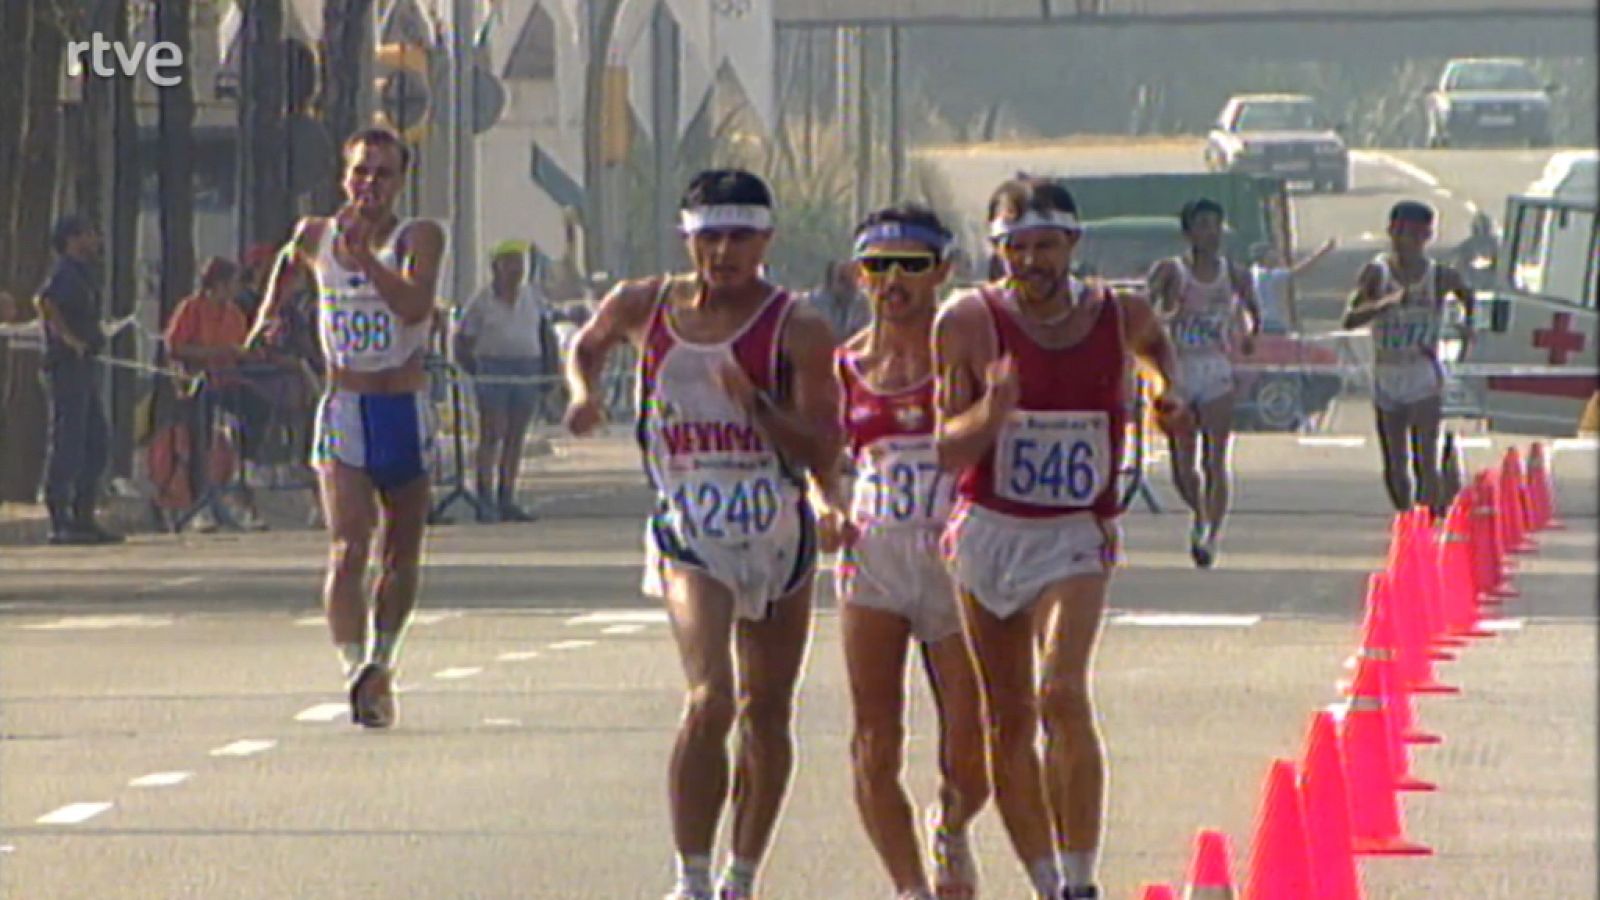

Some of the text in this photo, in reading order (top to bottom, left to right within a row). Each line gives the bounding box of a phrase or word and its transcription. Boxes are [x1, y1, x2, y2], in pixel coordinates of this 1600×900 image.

[333, 310, 391, 352] 598
[1010, 438, 1093, 499] 546
[673, 477, 778, 538] 1240
